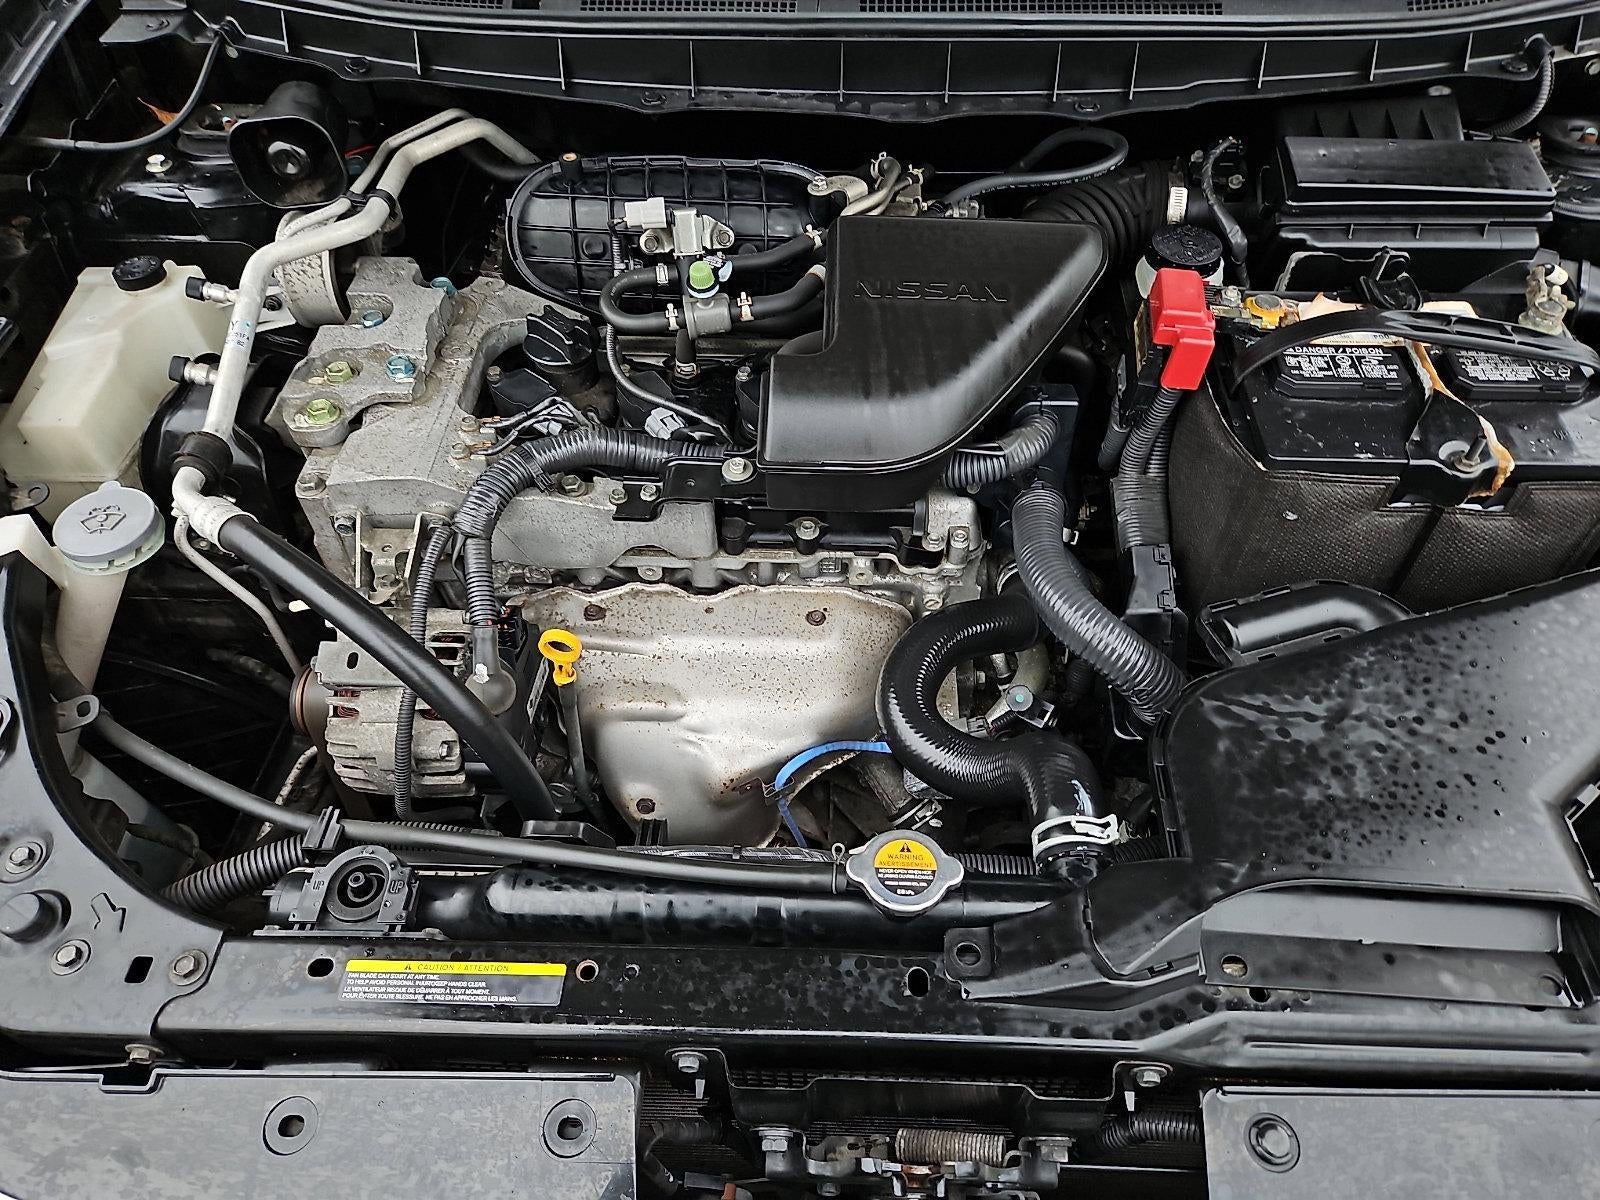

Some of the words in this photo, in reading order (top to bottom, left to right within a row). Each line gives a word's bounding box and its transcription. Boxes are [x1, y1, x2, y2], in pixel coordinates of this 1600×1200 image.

[853, 280, 1008, 302] NISSAN
[1295, 346, 1336, 354] DANGER
[1345, 347, 1384, 355] POISON
[887, 853, 924, 861] WARNING
[878, 860, 933, 868] AVERTISSEMENT
[312, 880, 325, 890] UP
[389, 880, 404, 893] UP
[417, 963, 455, 971] CAUTION
[463, 964, 510, 972] ATTENTION
